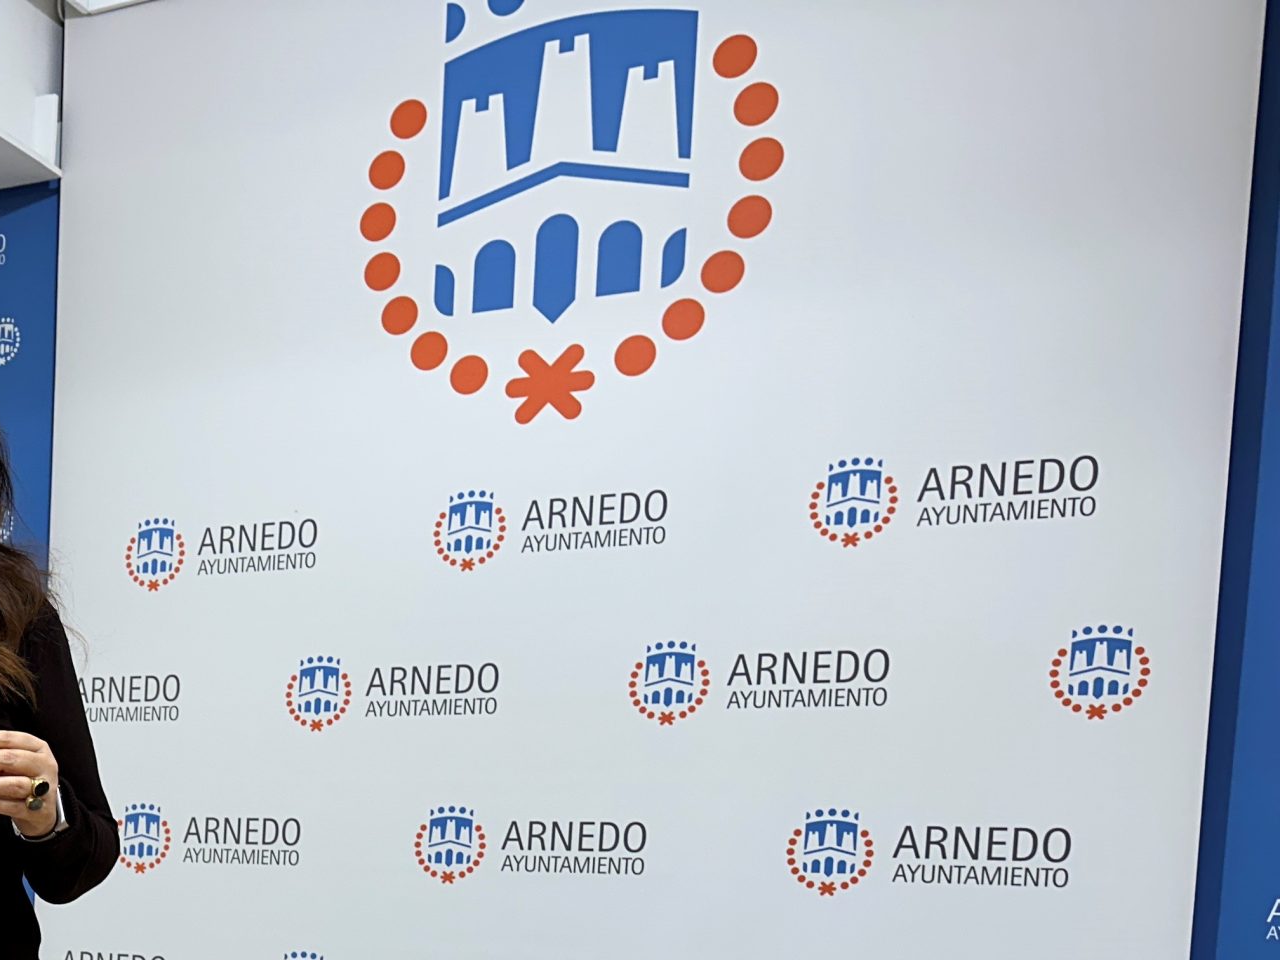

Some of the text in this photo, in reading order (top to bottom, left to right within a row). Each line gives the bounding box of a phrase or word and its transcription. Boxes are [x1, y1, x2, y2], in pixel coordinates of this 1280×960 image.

[919, 454, 1100, 502] ARNEDO
[522, 489, 669, 531] ARNEDO
[918, 497, 1096, 528] AYUNTAMIENTO
[198, 518, 318, 555] ARNEDO
[521, 525, 667, 553] AYUNTAMIENTO
[198, 551, 316, 575] AYUNTAMIENTO
[366, 662, 499, 697] ARNEDO
[727, 648, 890, 687] ARNEDO
[79, 674, 181, 703] ARNEDO
[726, 687, 888, 709] AYUNTAMIENTO
[86, 705, 180, 722] UNTAMIENTO
[366, 696, 498, 717] AYUNTAMIENTO
[184, 816, 301, 848] ARNEDO
[501, 820, 647, 853] ARNEDO
[893, 825, 1073, 864] ARNEDO
[183, 846, 300, 866] AYUNTAMIENTO
[501, 853, 645, 876] AYUNTAMIENTO
[892, 864, 1069, 889] AYUNTAMIENTO
